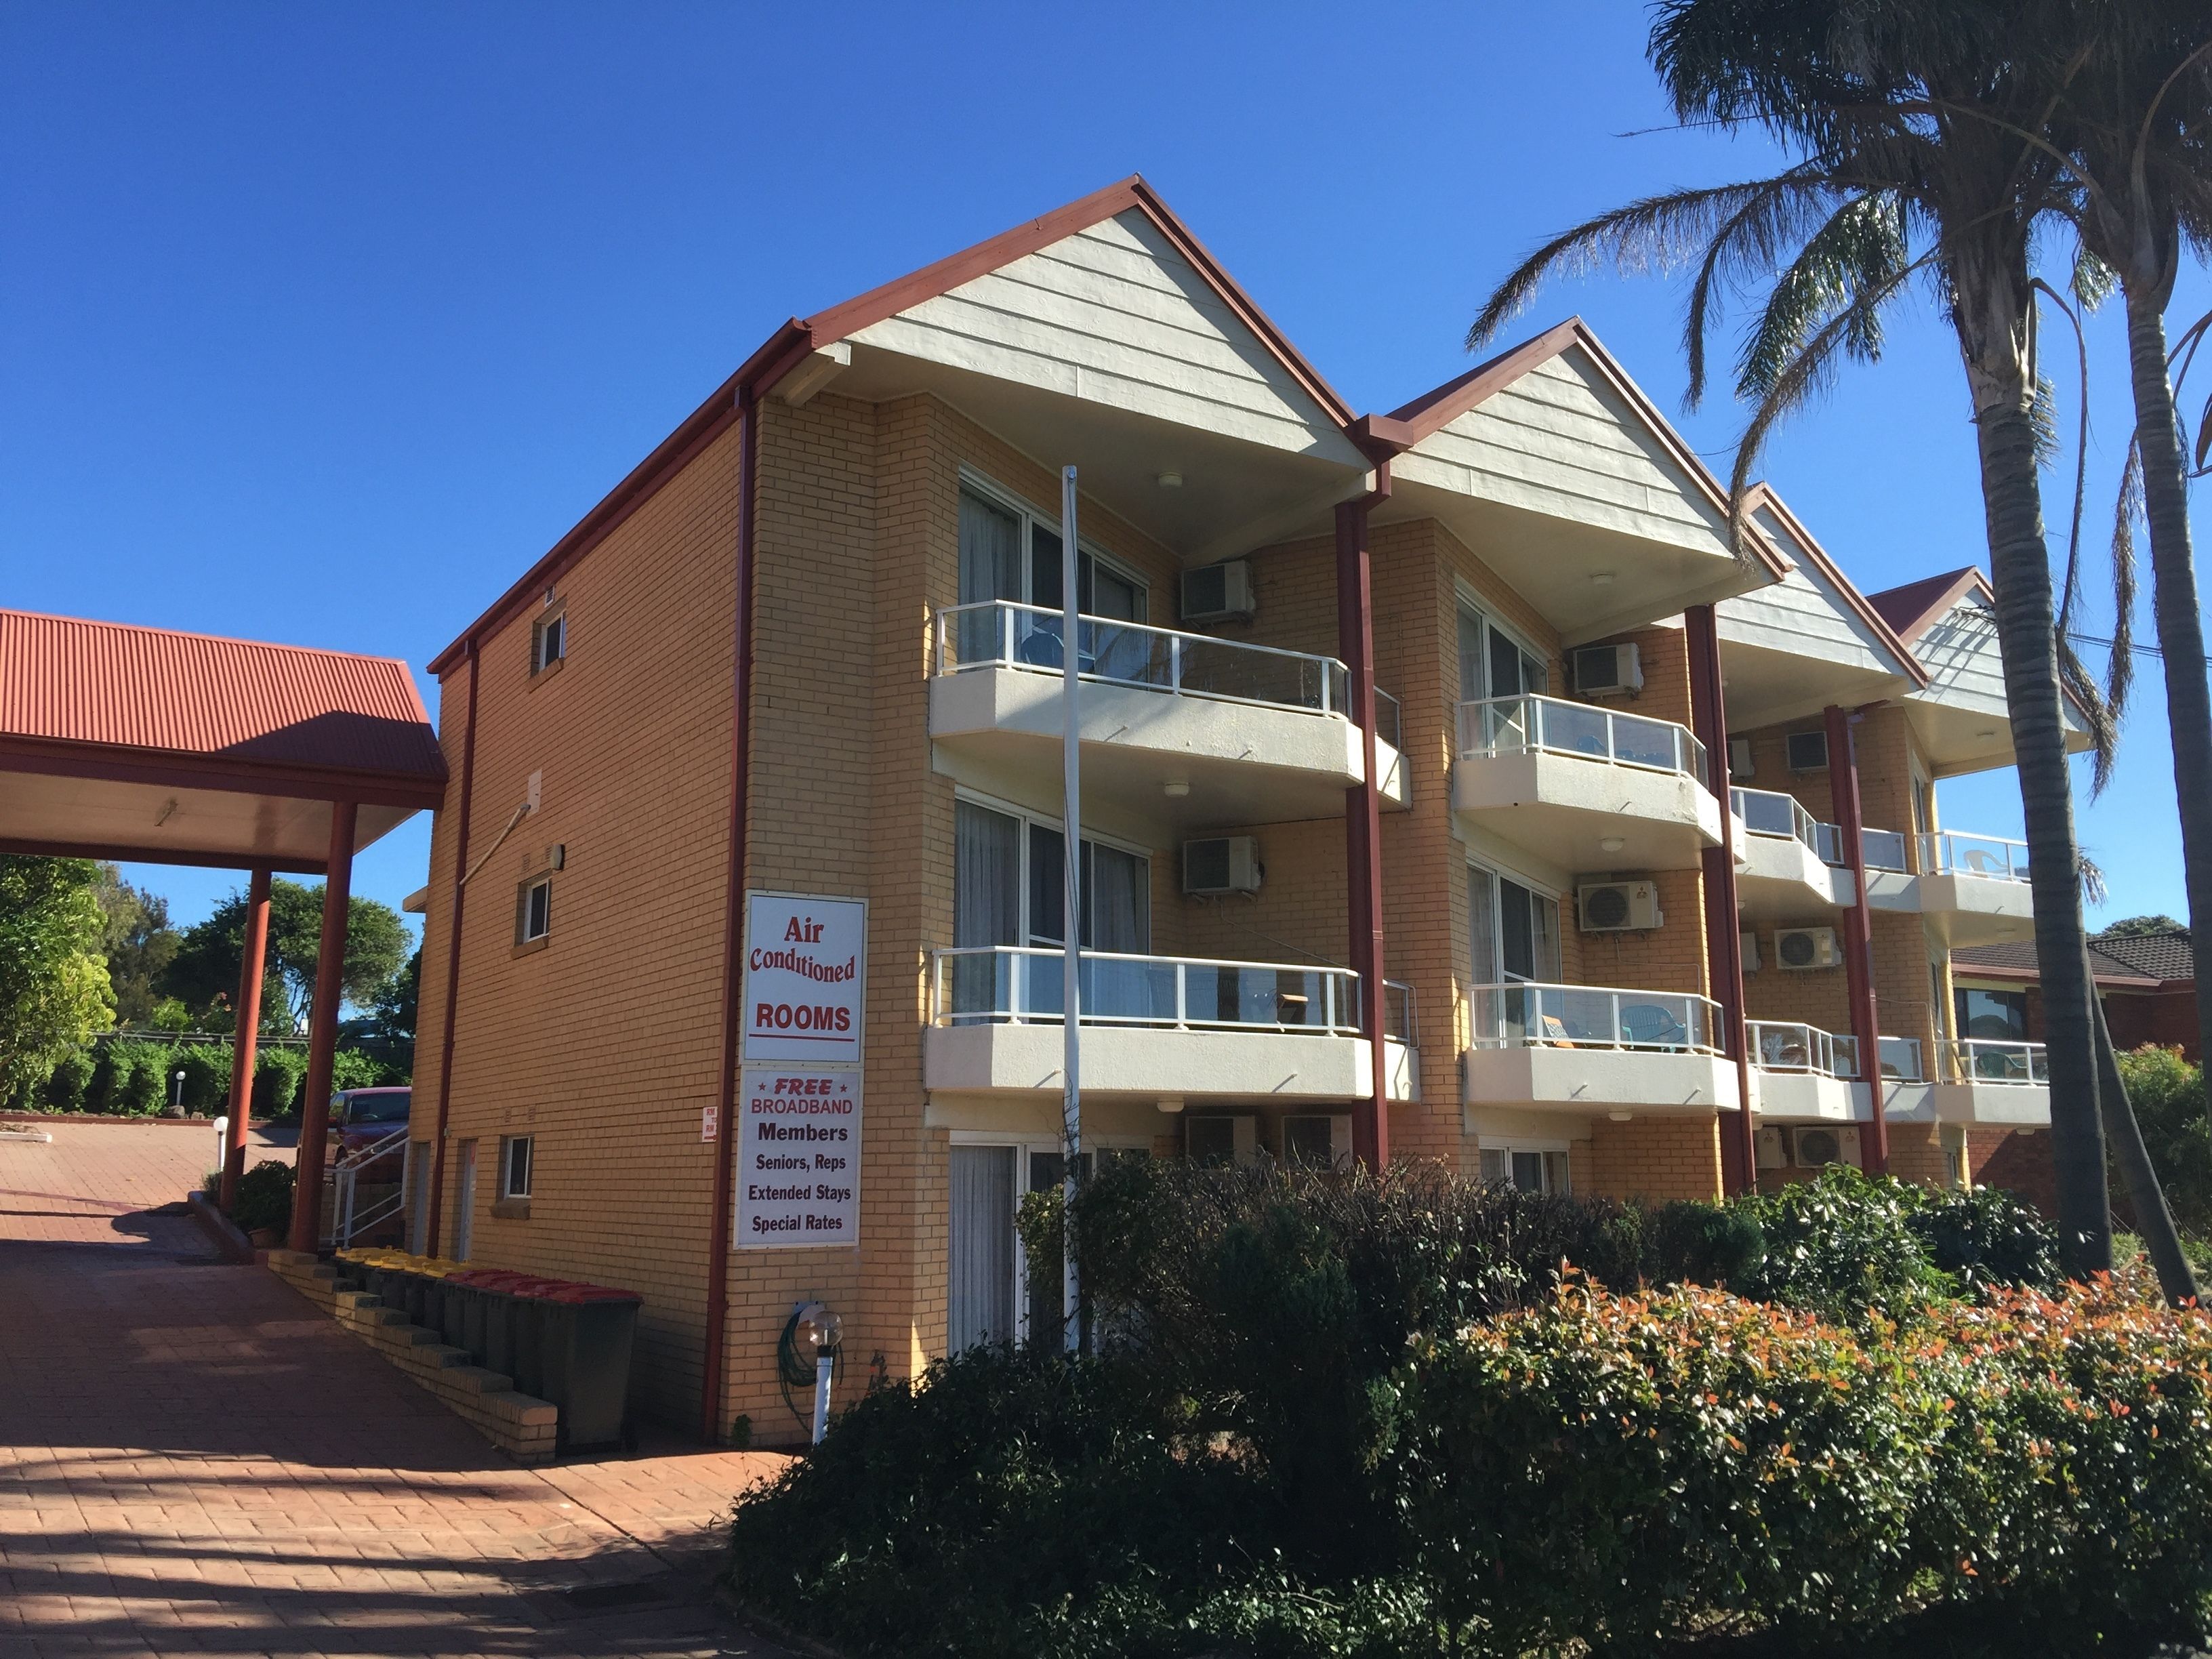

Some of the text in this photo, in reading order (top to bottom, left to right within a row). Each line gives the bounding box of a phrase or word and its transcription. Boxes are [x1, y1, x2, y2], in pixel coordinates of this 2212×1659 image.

[784, 916, 824, 943] Air
[750, 947, 855, 983] Conditioned
[756, 1003, 851, 1031] ROOMS
[774, 1078, 834, 1096] FREE
[751, 1099, 853, 1114] BROADBAND
[758, 1122, 848, 1141] Members
[756, 1153, 846, 1173] Seniors, Reps
[748, 1184, 851, 1203] Extended Stays
[752, 1214, 843, 1235] Special Rates
